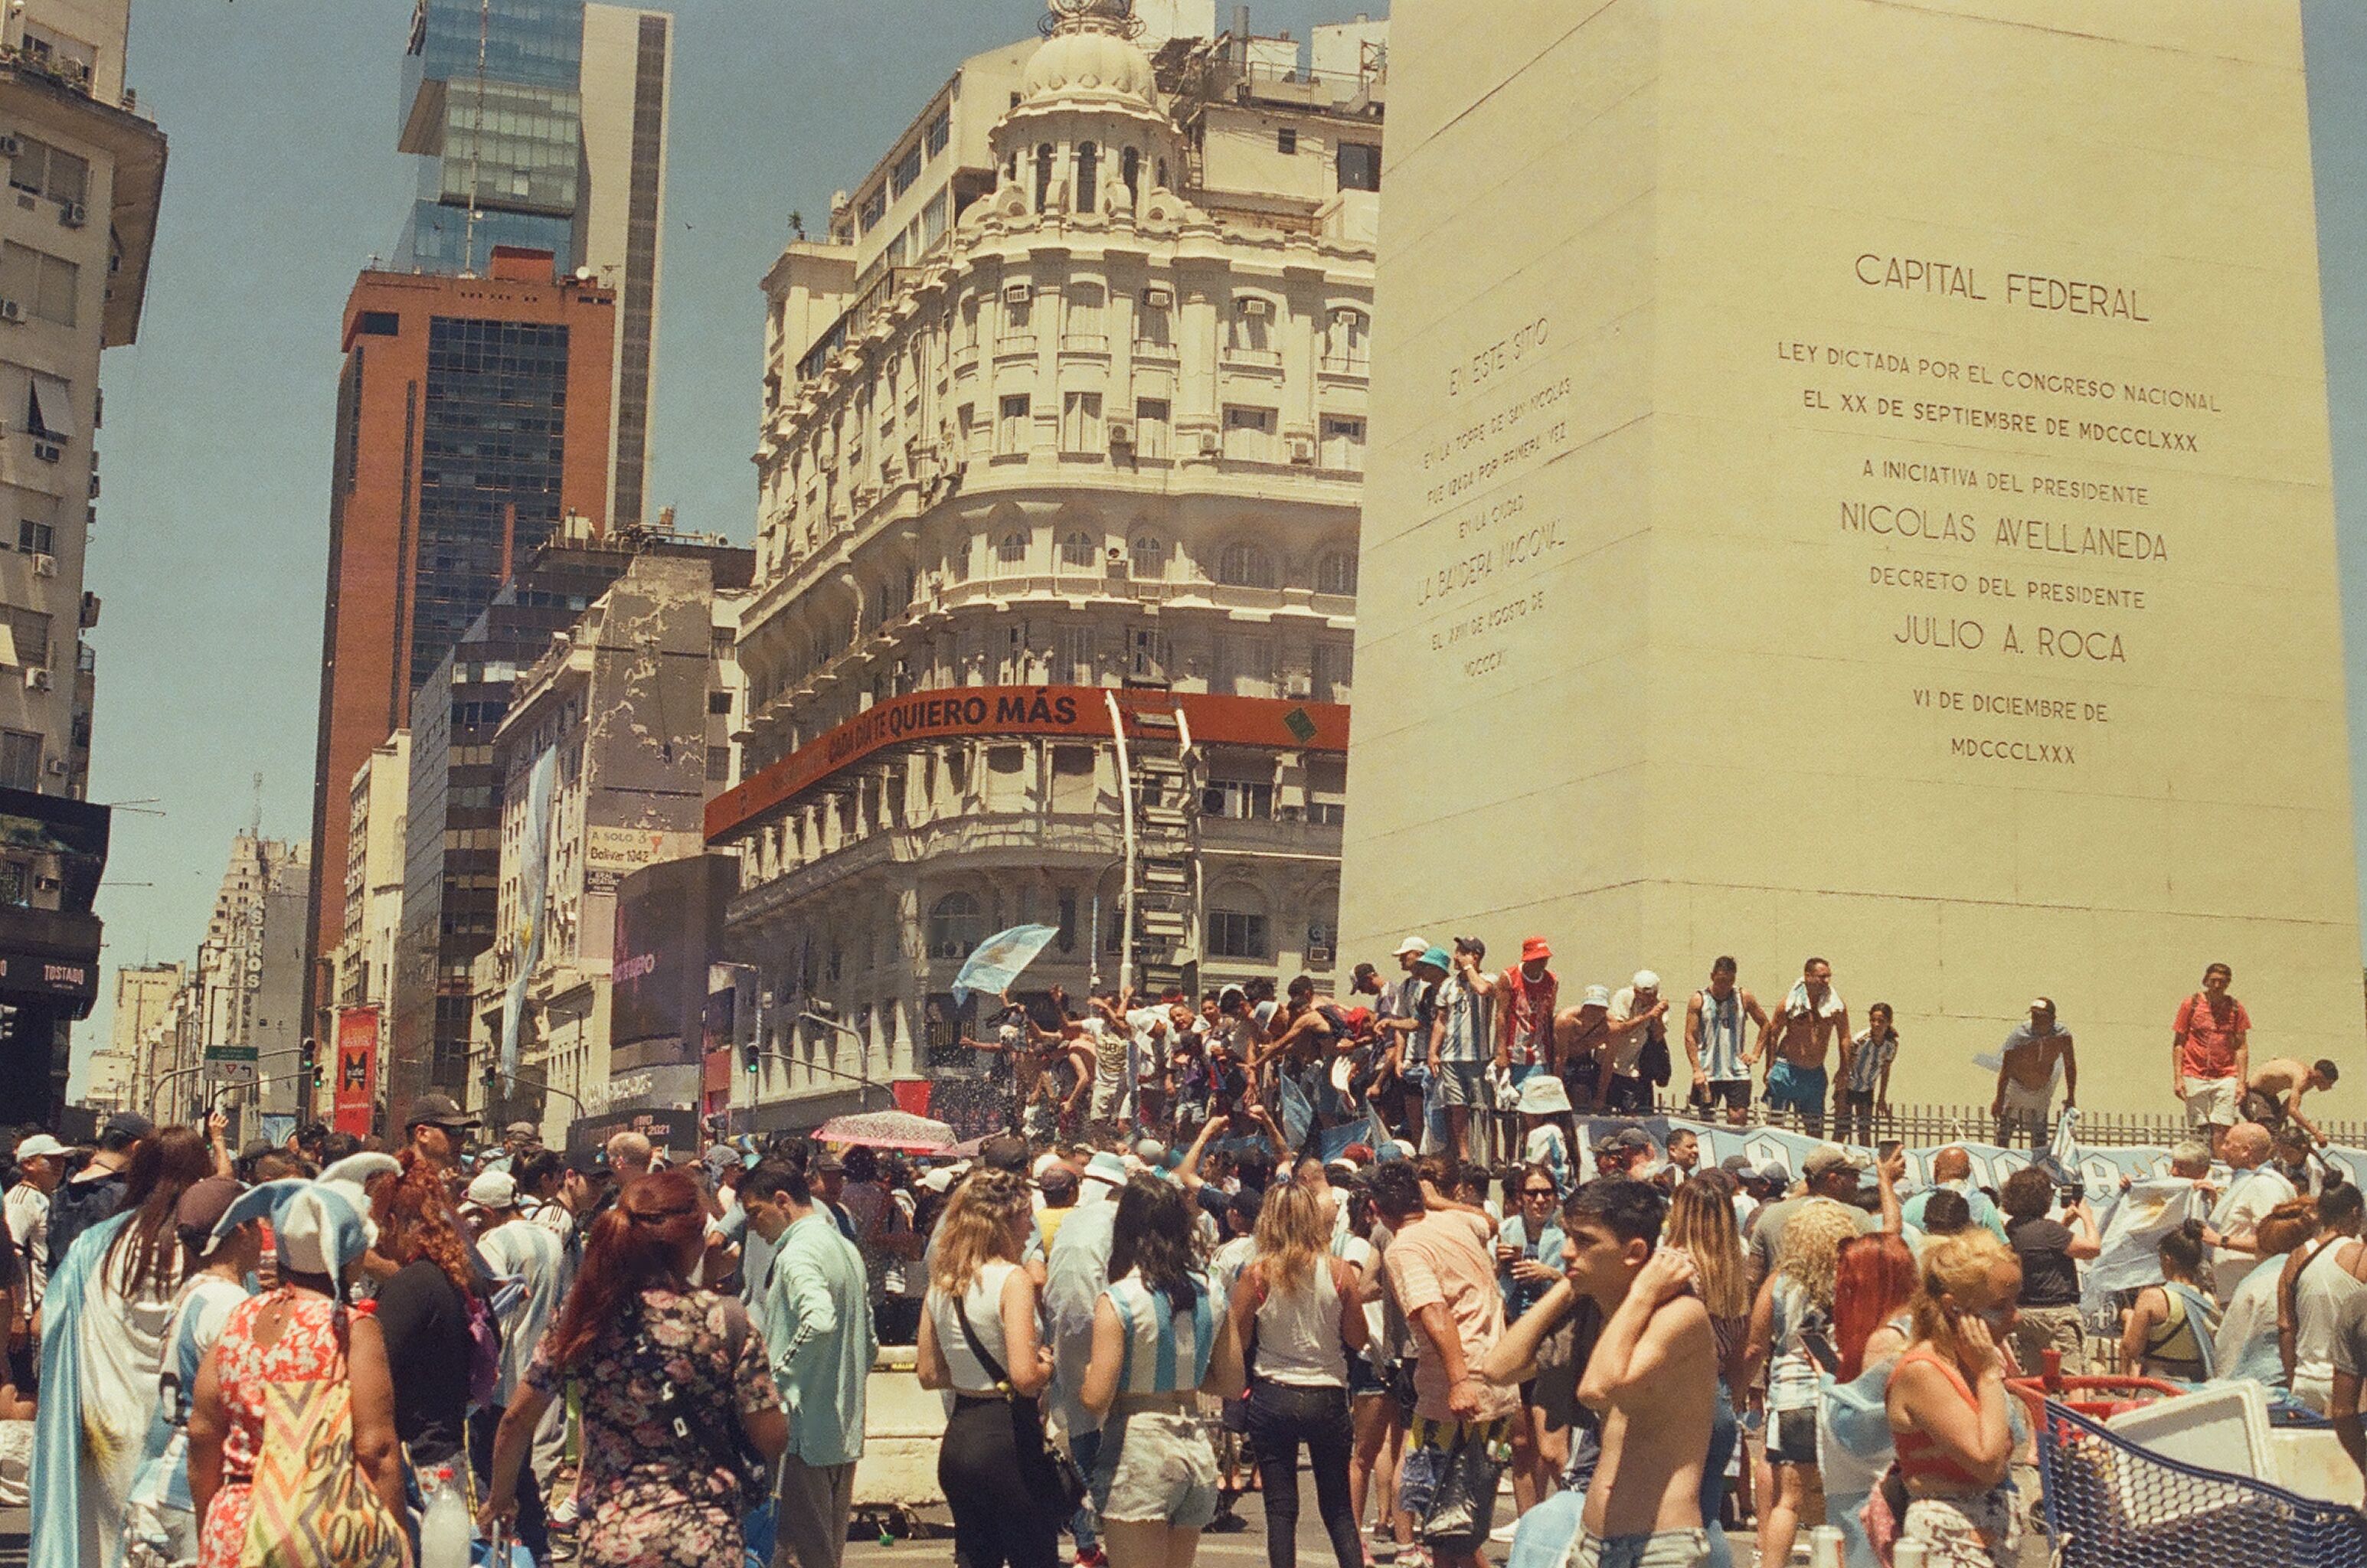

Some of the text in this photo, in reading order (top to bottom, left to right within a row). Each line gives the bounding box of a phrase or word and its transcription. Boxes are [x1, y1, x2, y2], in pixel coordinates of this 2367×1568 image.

[1854, 253, 2150, 322] CAPITAL FEDERAL
[1472, 339, 1508, 384] ESTE
[1777, 341, 2222, 413] LEY DICTADA POR EL CONGRESO NACIONAL
[1803, 390, 2199, 452] EL XX DE SEPTIEMBRE DE MDCCCLXXX
[1862, 459, 2150, 506] A INICIATIVA DEL PRESIDENTE
[1839, 501, 2169, 562] NICOLAS AVELLANEDA
[1869, 565, 2146, 609] DECRETO DEL PRESIDENTE
[1894, 614, 2127, 663] JULIO A. ROCA
[889, 697, 987, 737] QUIERO
[997, 688, 1077, 725] MÁS
[1913, 688, 2109, 723] VI DE DICIEMBRE DE
[1950, 737, 2076, 765] MDCCCLXXX
[603, 832, 633, 843] SOLO
[249, 895, 265, 988] ASTROS
[44, 964, 84, 985] TOSTADO
[647, 1125, 671, 1135] 2021
